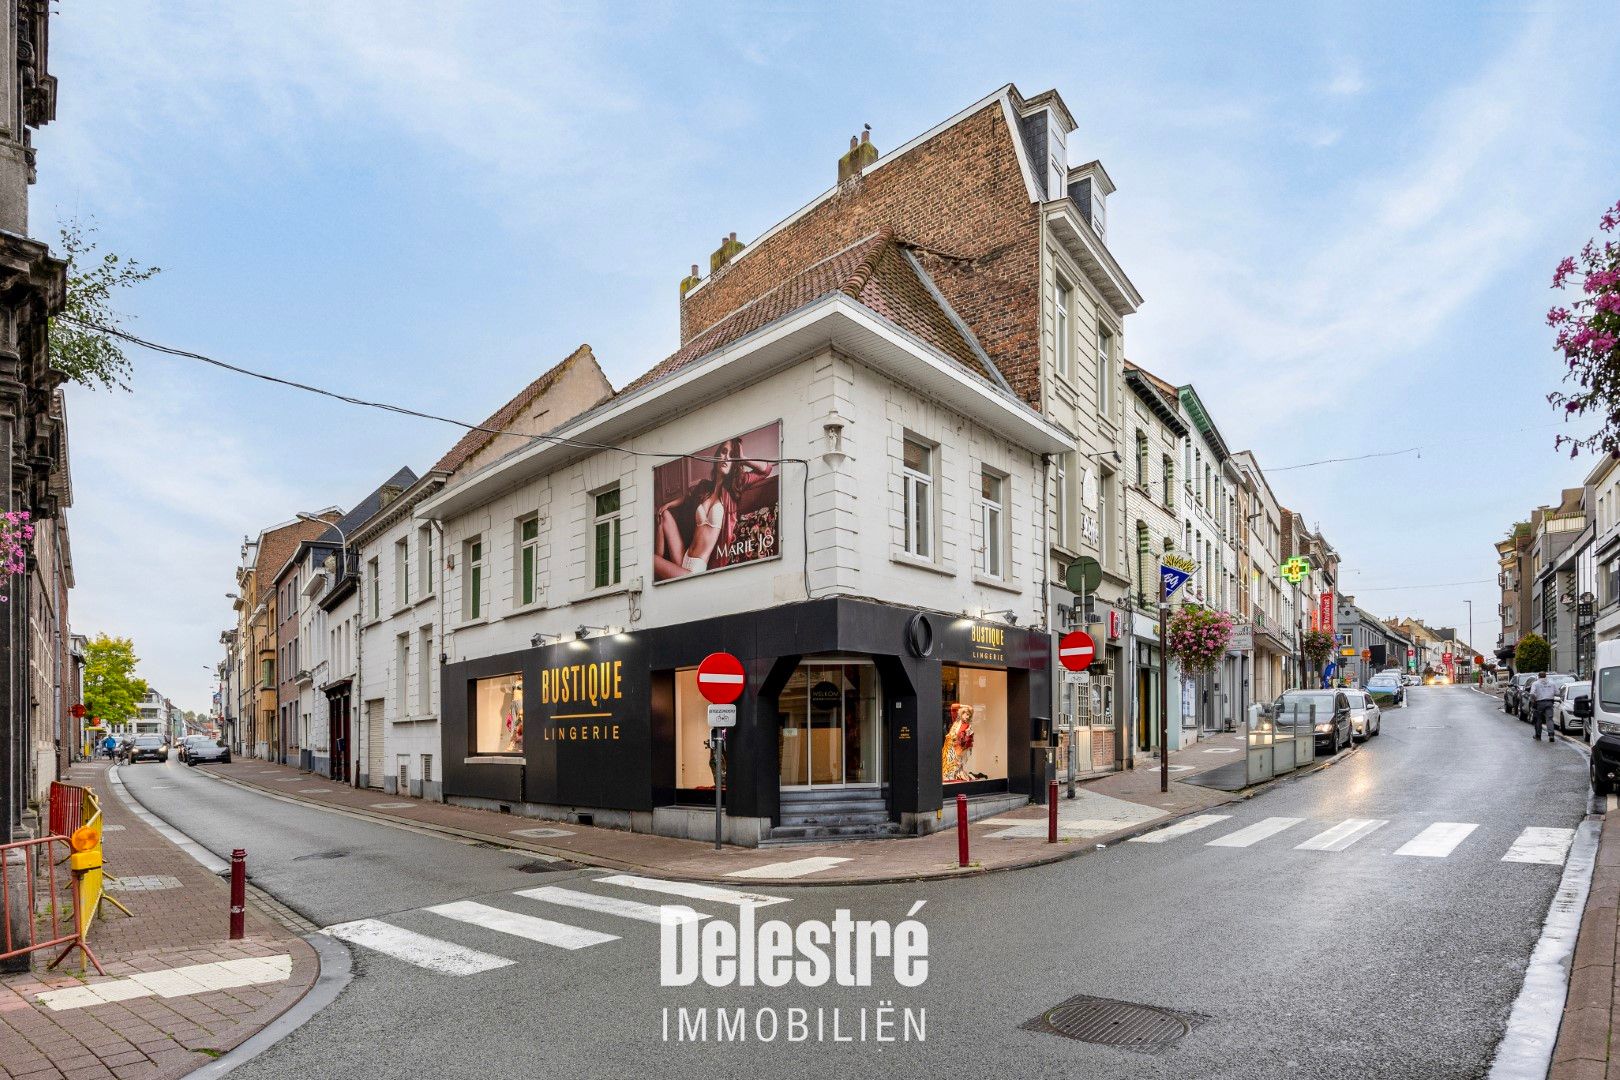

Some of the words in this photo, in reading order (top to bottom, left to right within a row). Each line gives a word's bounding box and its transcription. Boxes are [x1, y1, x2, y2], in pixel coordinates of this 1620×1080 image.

[716, 539, 755, 559] MARIE
[758, 533, 774, 552] JO
[971, 625, 1004, 647] BUSTIQUE
[972, 651, 1004, 662] LINGERIE
[541, 660, 622, 707] BUSTIQUE
[544, 725, 620, 741] LINGERIE
